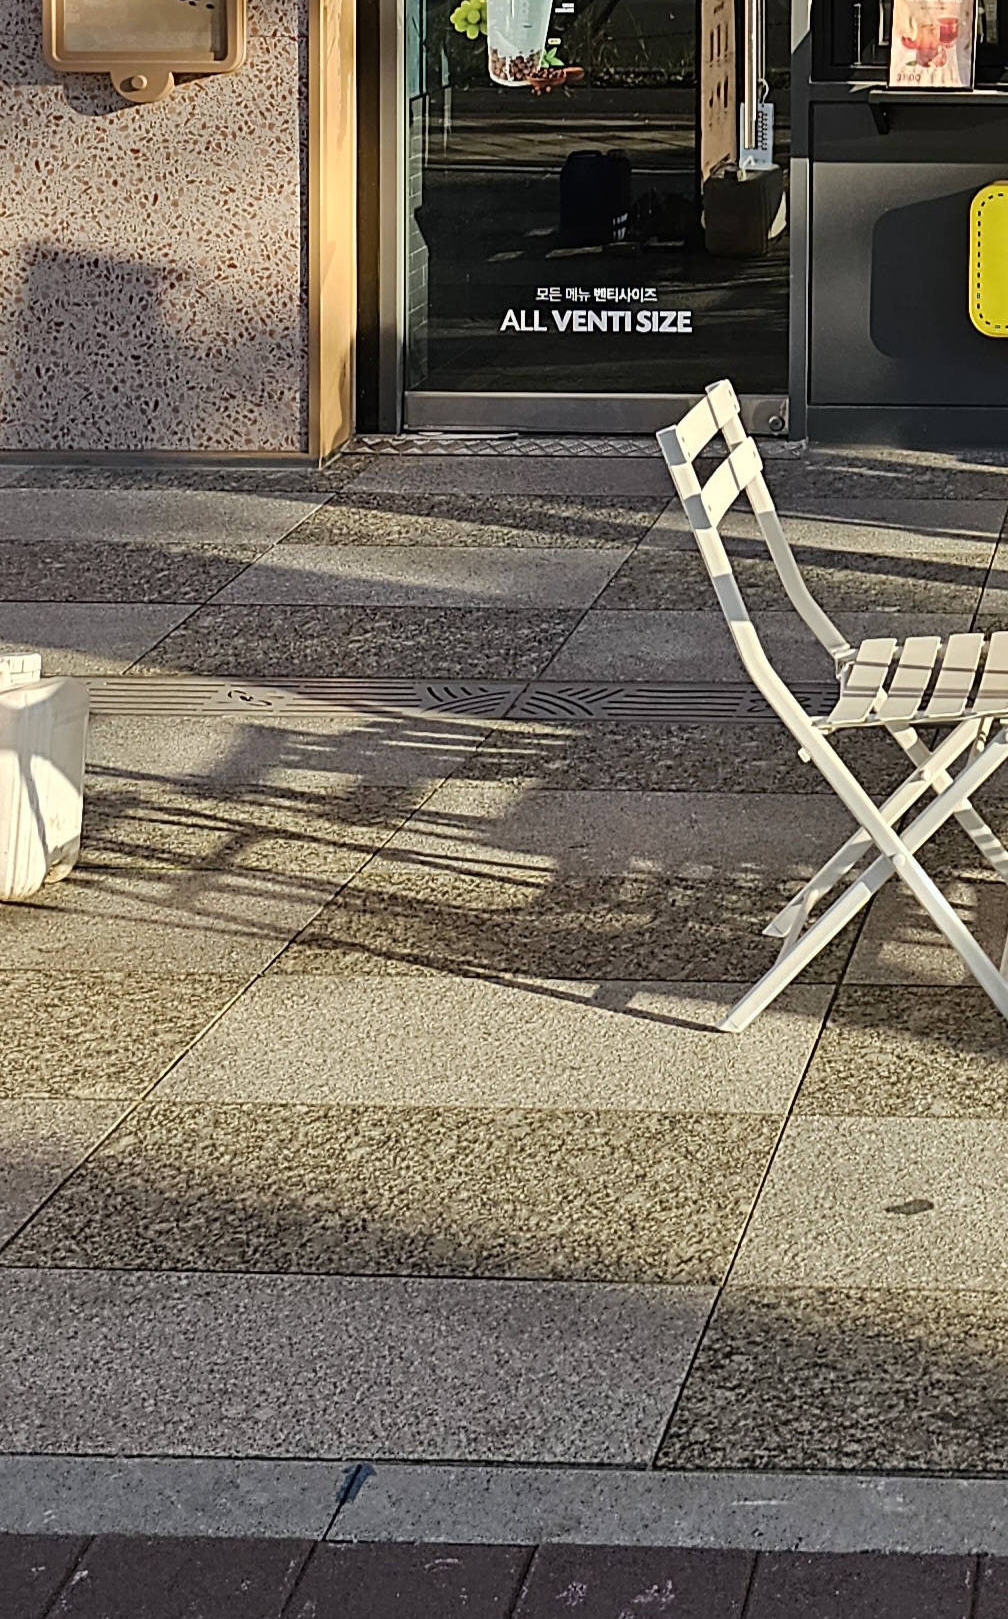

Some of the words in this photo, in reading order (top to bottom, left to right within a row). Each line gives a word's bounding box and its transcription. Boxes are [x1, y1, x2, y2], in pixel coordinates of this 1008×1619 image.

[535, 287, 562, 301] 모든
[566, 287, 591, 302] 메뉴
[593, 287, 658, 302] 벤티사이즈
[500, 309, 547, 332] ALL
[551, 309, 632, 332] VENTI
[635, 310, 693, 333] SIZE
